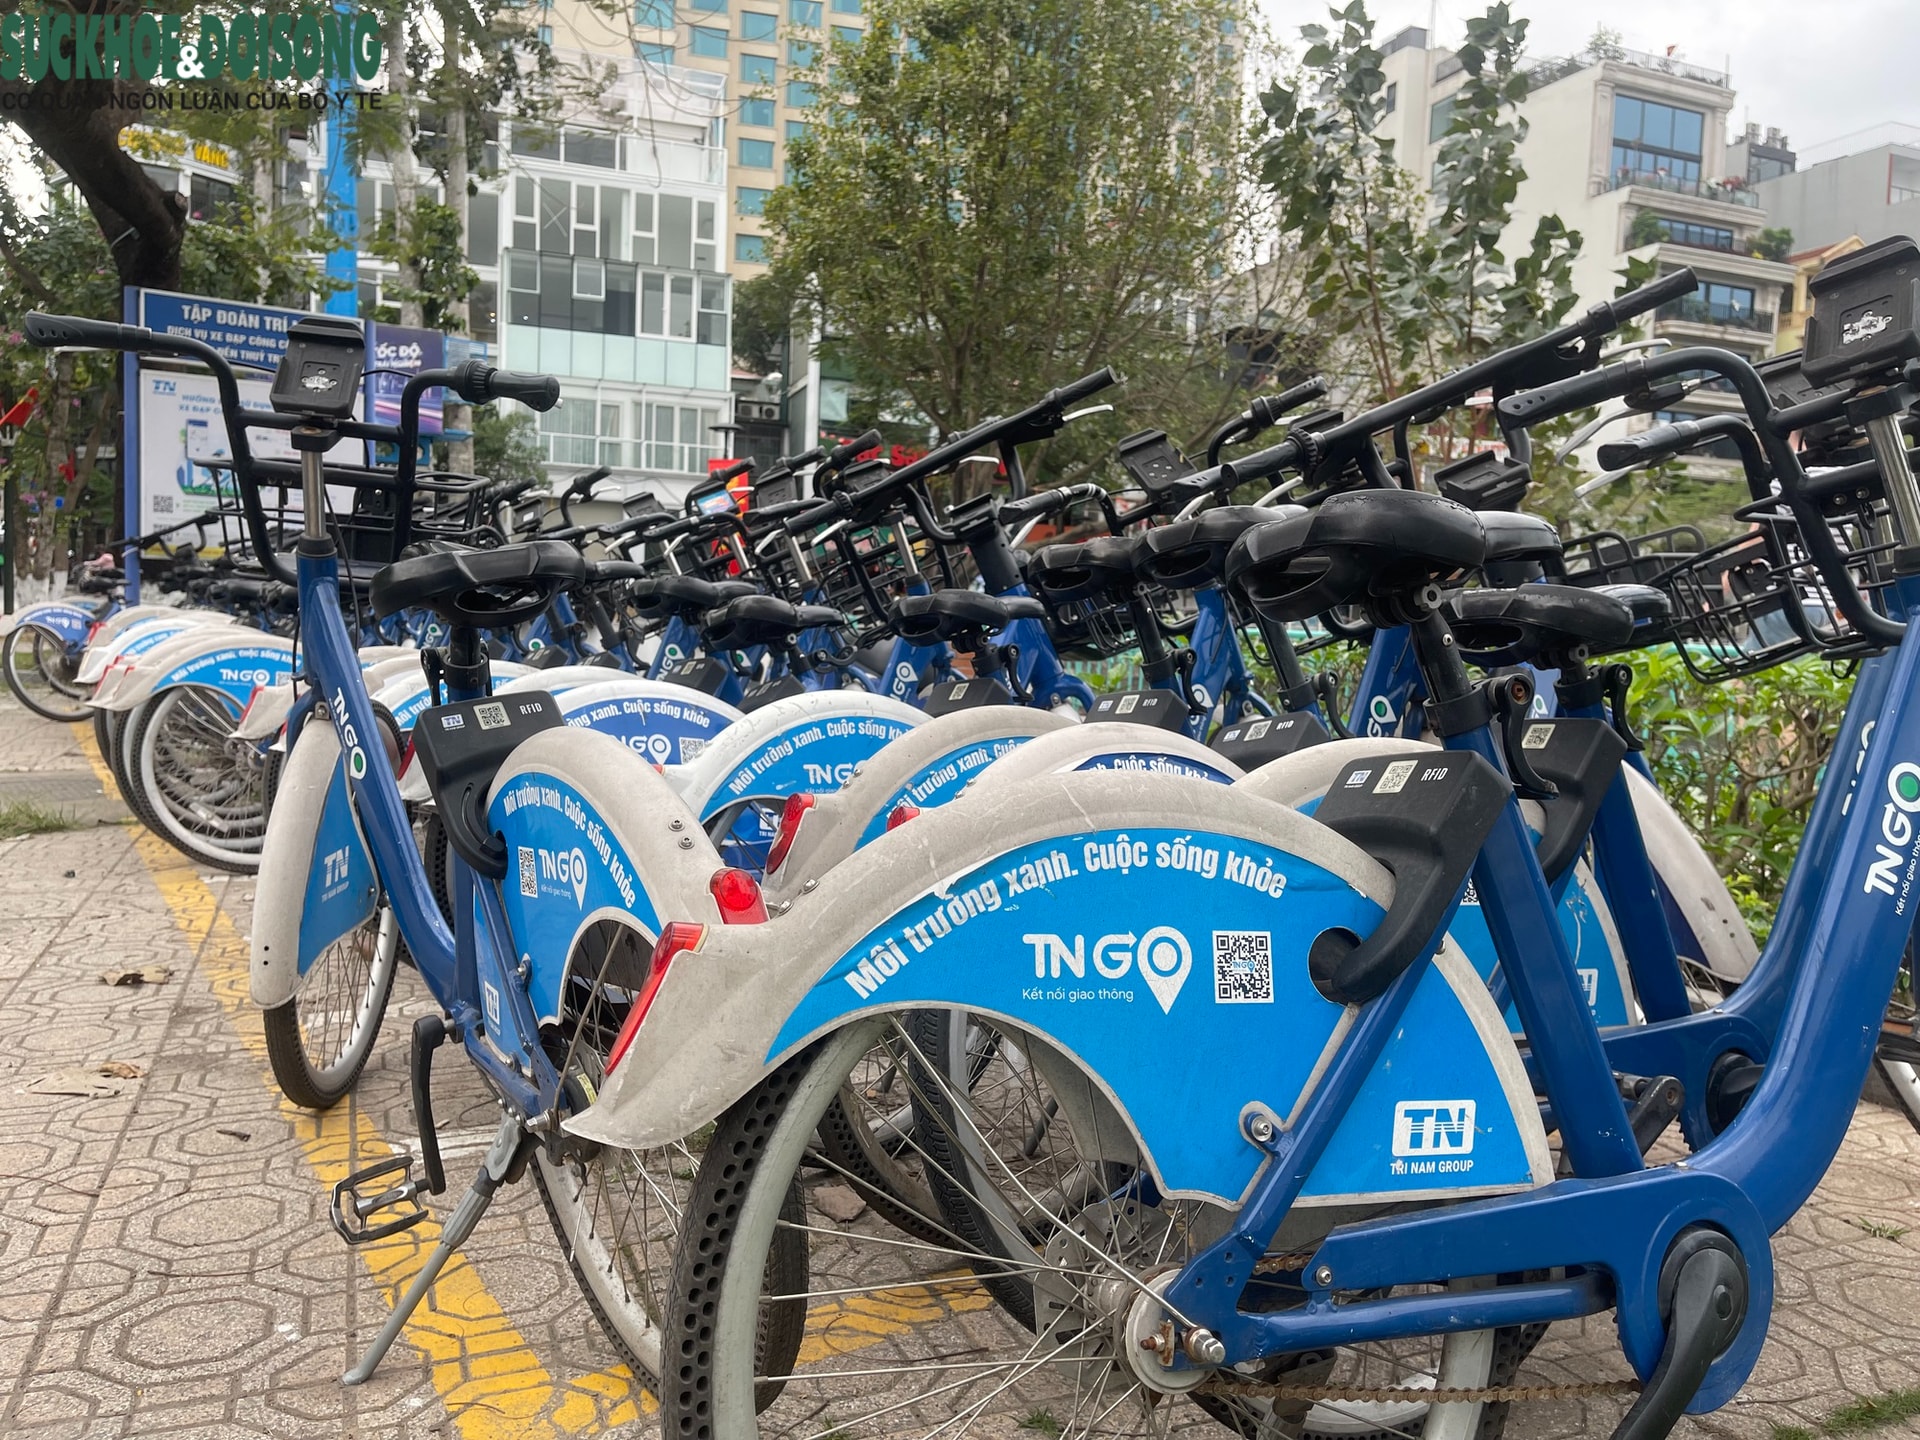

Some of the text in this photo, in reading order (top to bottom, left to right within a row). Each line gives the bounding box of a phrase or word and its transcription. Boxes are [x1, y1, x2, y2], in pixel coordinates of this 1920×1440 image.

[181, 303, 289, 334] TẬP ĐOÀN TRÍ
[210, 330, 225, 343] XE
[219, 667, 271, 686] TNGO
[519, 702, 543, 716] RFID
[591, 701, 621, 725] xanh.
[653, 699, 682, 720] sống
[728, 769, 756, 796] Môi
[750, 746, 795, 774] trường
[792, 725, 827, 750] xanh.
[826, 718, 857, 738] Cuộc
[857, 718, 887, 740] sống
[911, 765, 959, 803] trường
[956, 747, 993, 774] xanh.
[1420, 767, 1449, 782] RFID
[502, 781, 637, 910] Môi trường xanh. Cuộc sống khỏe
[537, 846, 588, 912] TNGO
[843, 936, 911, 1000] Môi
[1001, 849, 1079, 898] xanh.
[1082, 833, 1149, 875] Cuộc
[1154, 834, 1220, 880] sống
[1223, 850, 1288, 900] khỏe
[1022, 925, 1193, 1016] TNGO
[1022, 986, 1134, 1003] Kết nối giao thông
[1403, 1106, 1467, 1150] TN
[1410, 1160, 1437, 1175] NAM
[1438, 1159, 1475, 1174] GROUP
